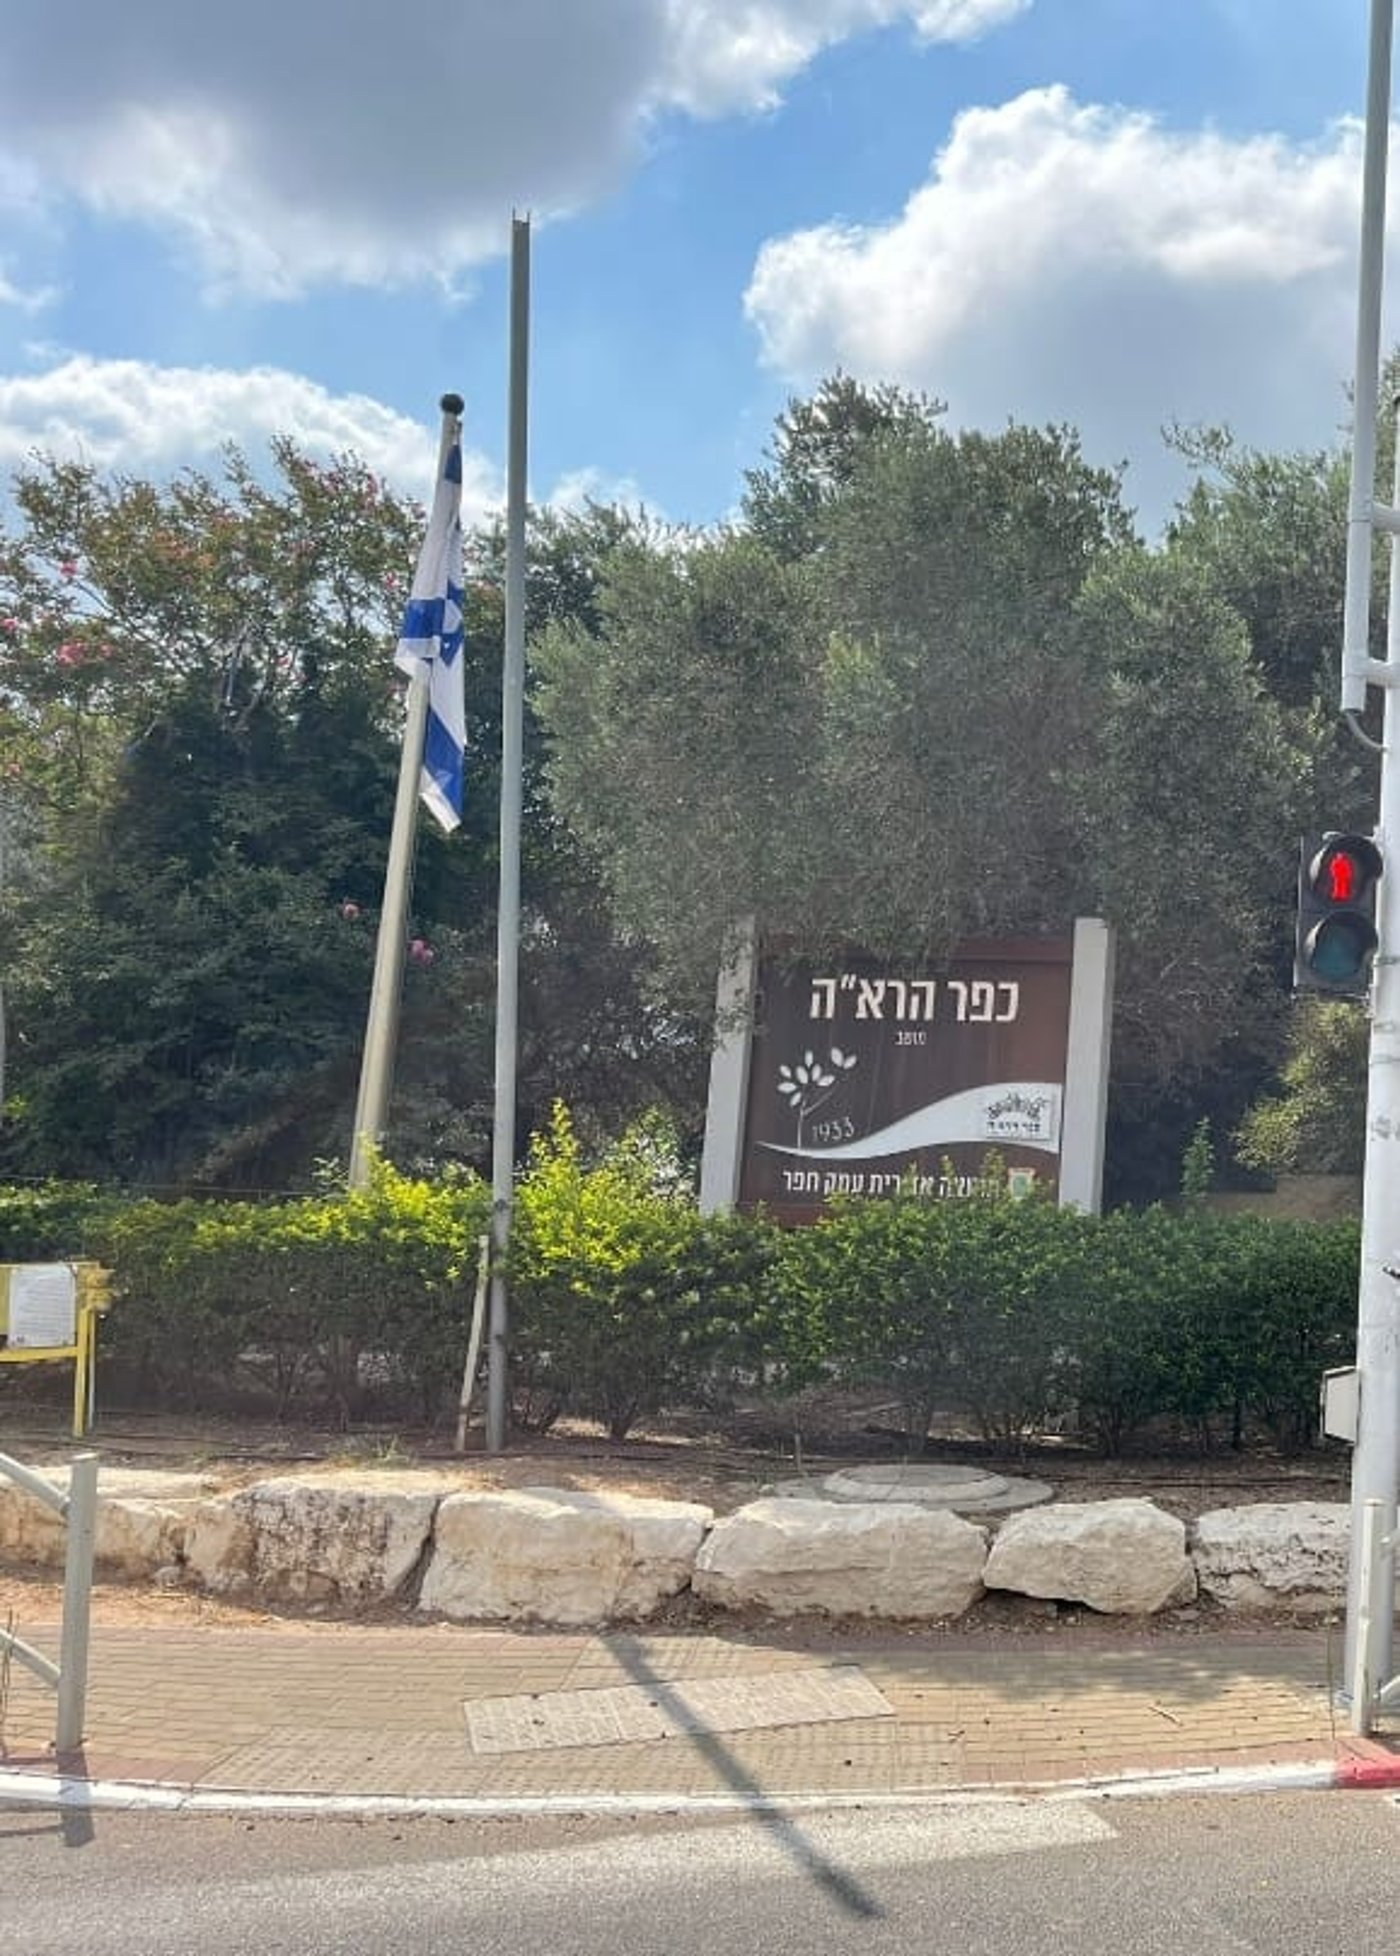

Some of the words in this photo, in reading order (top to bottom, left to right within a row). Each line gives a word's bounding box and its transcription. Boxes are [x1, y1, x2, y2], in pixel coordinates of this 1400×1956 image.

[810, 973, 936, 1021] הרא"ה
[947, 981, 1019, 1021] כפר
[812, 1116, 854, 1142] 1933
[783, 1170, 819, 1192] חפר
[823, 1171, 864, 1196] עמק
[868, 1174, 934, 1196] אזרית
